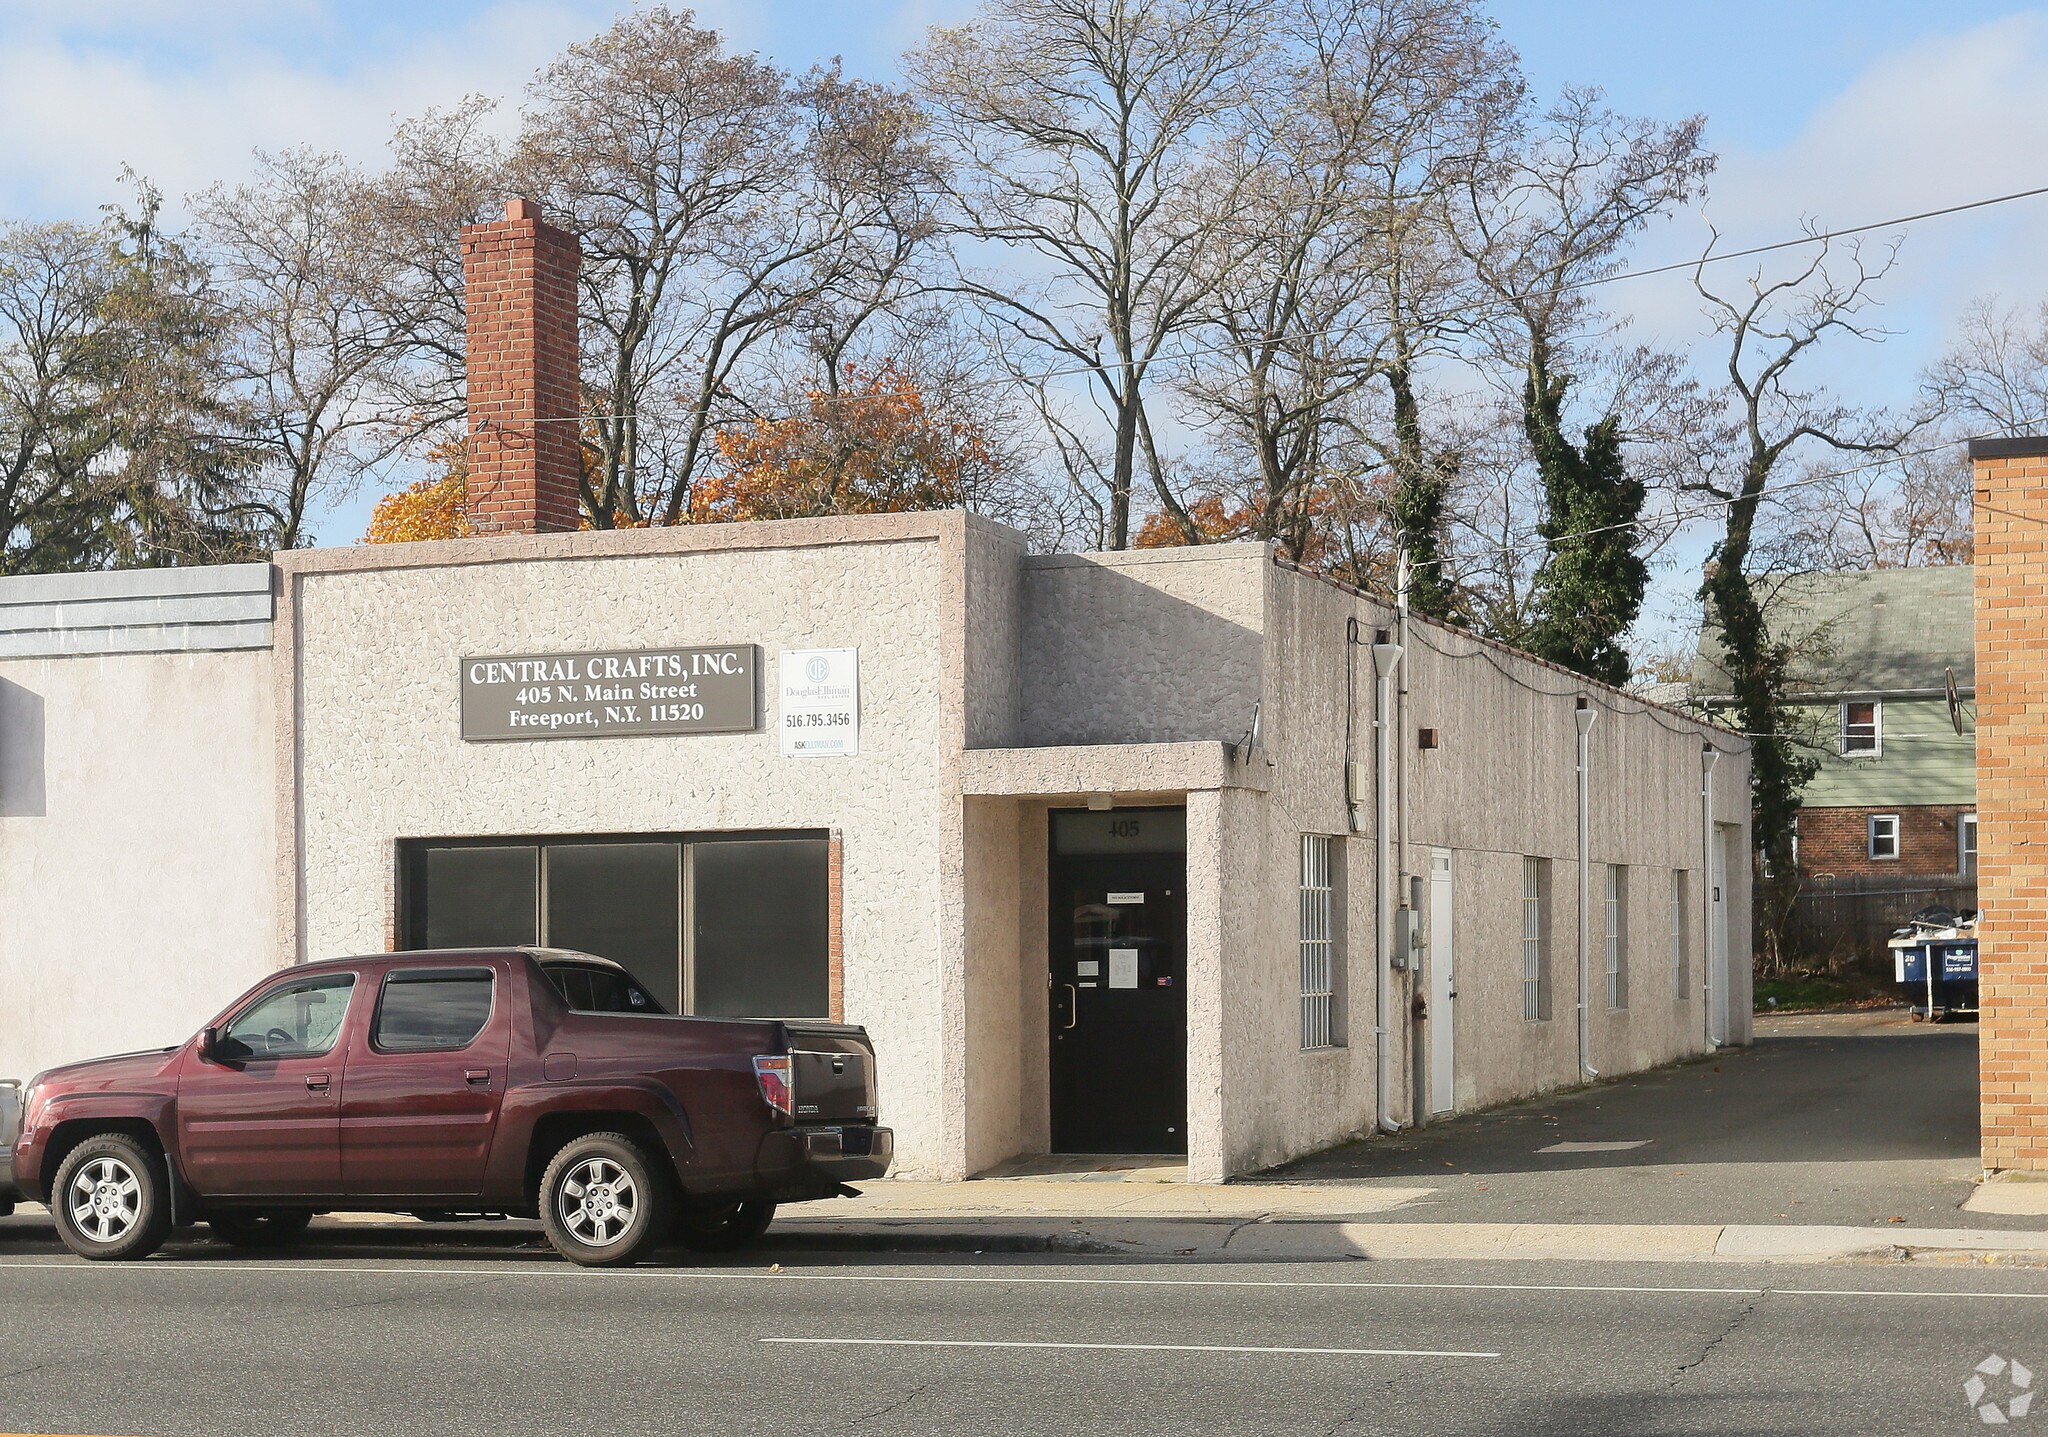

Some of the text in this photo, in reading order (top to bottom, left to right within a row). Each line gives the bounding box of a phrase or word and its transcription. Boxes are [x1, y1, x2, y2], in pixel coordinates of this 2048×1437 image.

[470, 653, 744, 685] CENTRAL CRAFTS, INC.
[515, 682, 697, 705] 405 N. Main Street
[509, 704, 704, 729] Freeport, N.Y. 11520
[786, 713, 850, 727] 516.795.3456
[1108, 821, 1140, 837] 405
